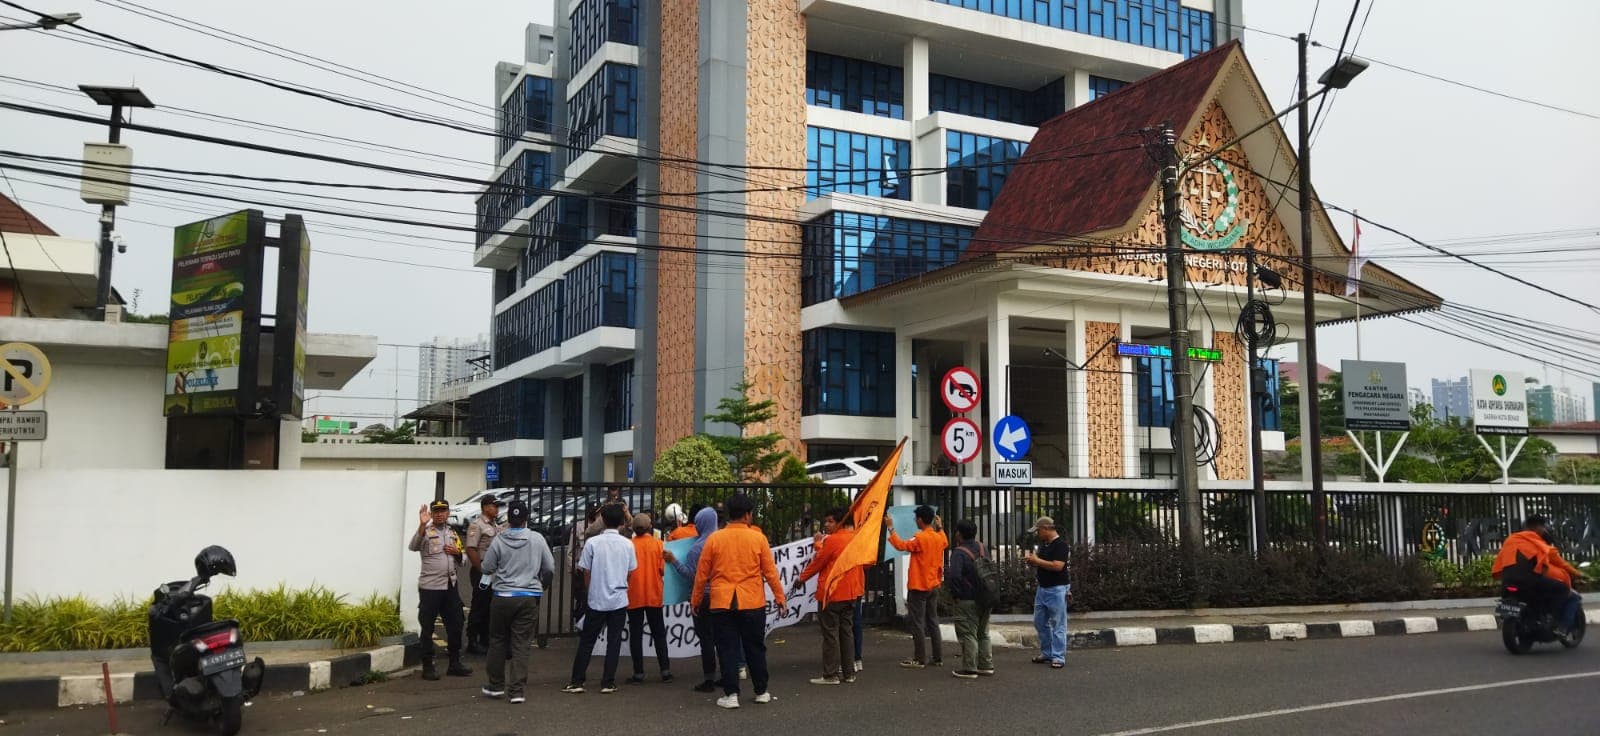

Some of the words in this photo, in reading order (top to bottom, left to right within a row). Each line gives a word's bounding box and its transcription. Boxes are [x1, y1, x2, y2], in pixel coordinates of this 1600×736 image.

[1348, 391, 1382, 399] PENGACARA
[1382, 392, 1405, 400] NEGARA
[17, 416, 41, 424] RAMBU
[953, 428, 965, 453] 5
[998, 468, 1028, 478] MASUK
